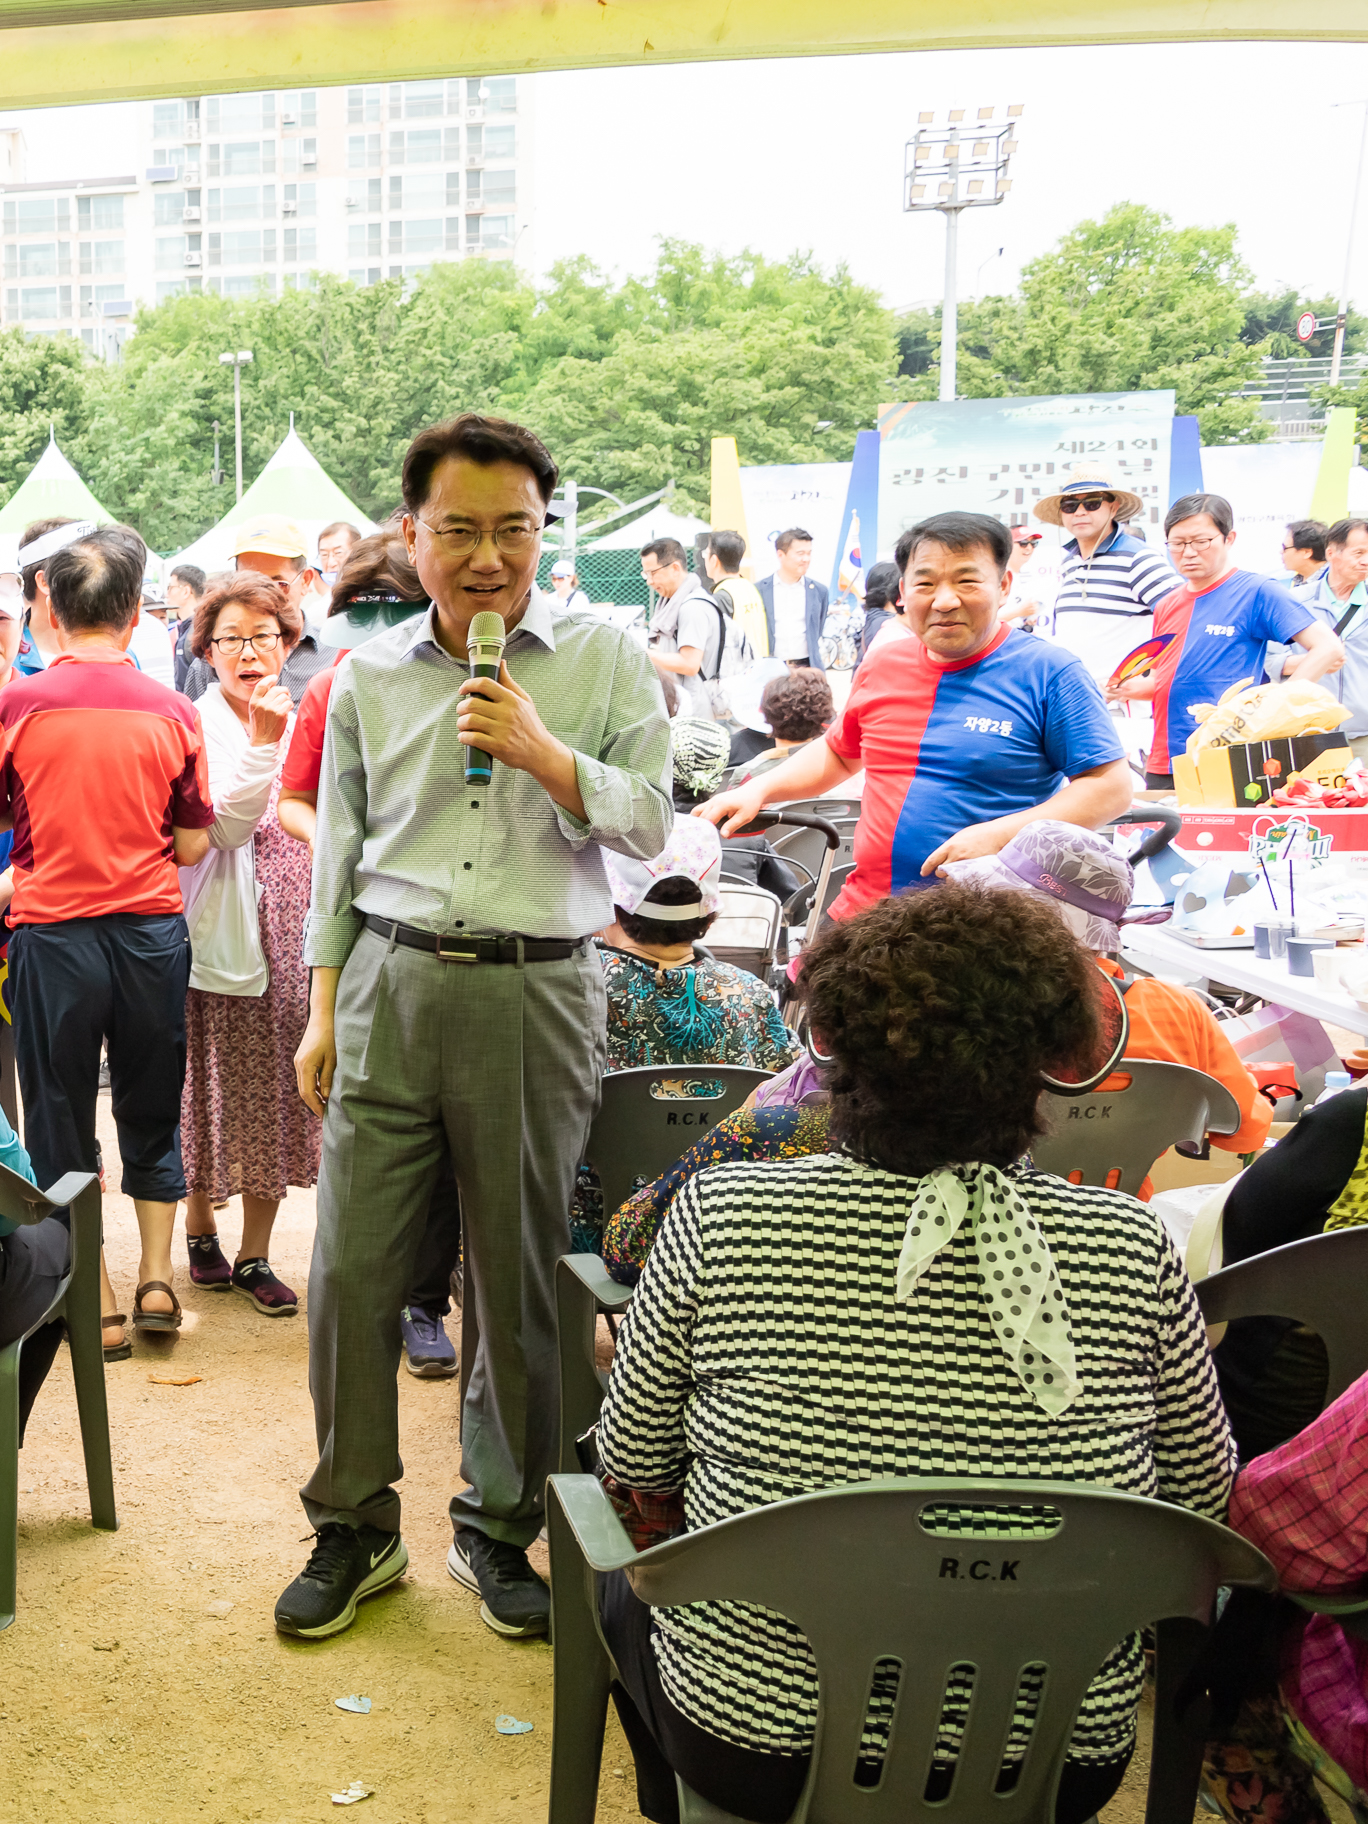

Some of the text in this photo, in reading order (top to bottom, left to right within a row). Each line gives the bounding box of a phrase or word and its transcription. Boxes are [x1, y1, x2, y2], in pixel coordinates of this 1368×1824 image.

[1053, 438, 1158, 454] 제24회
[1204, 624, 1236, 637] 자양2동
[963, 716, 1013, 737] 자양2동
[666, 1111, 711, 1126] R.C.K
[1067, 1105, 1113, 1121] R.C.K
[939, 1556, 1021, 1582] R.C.K
